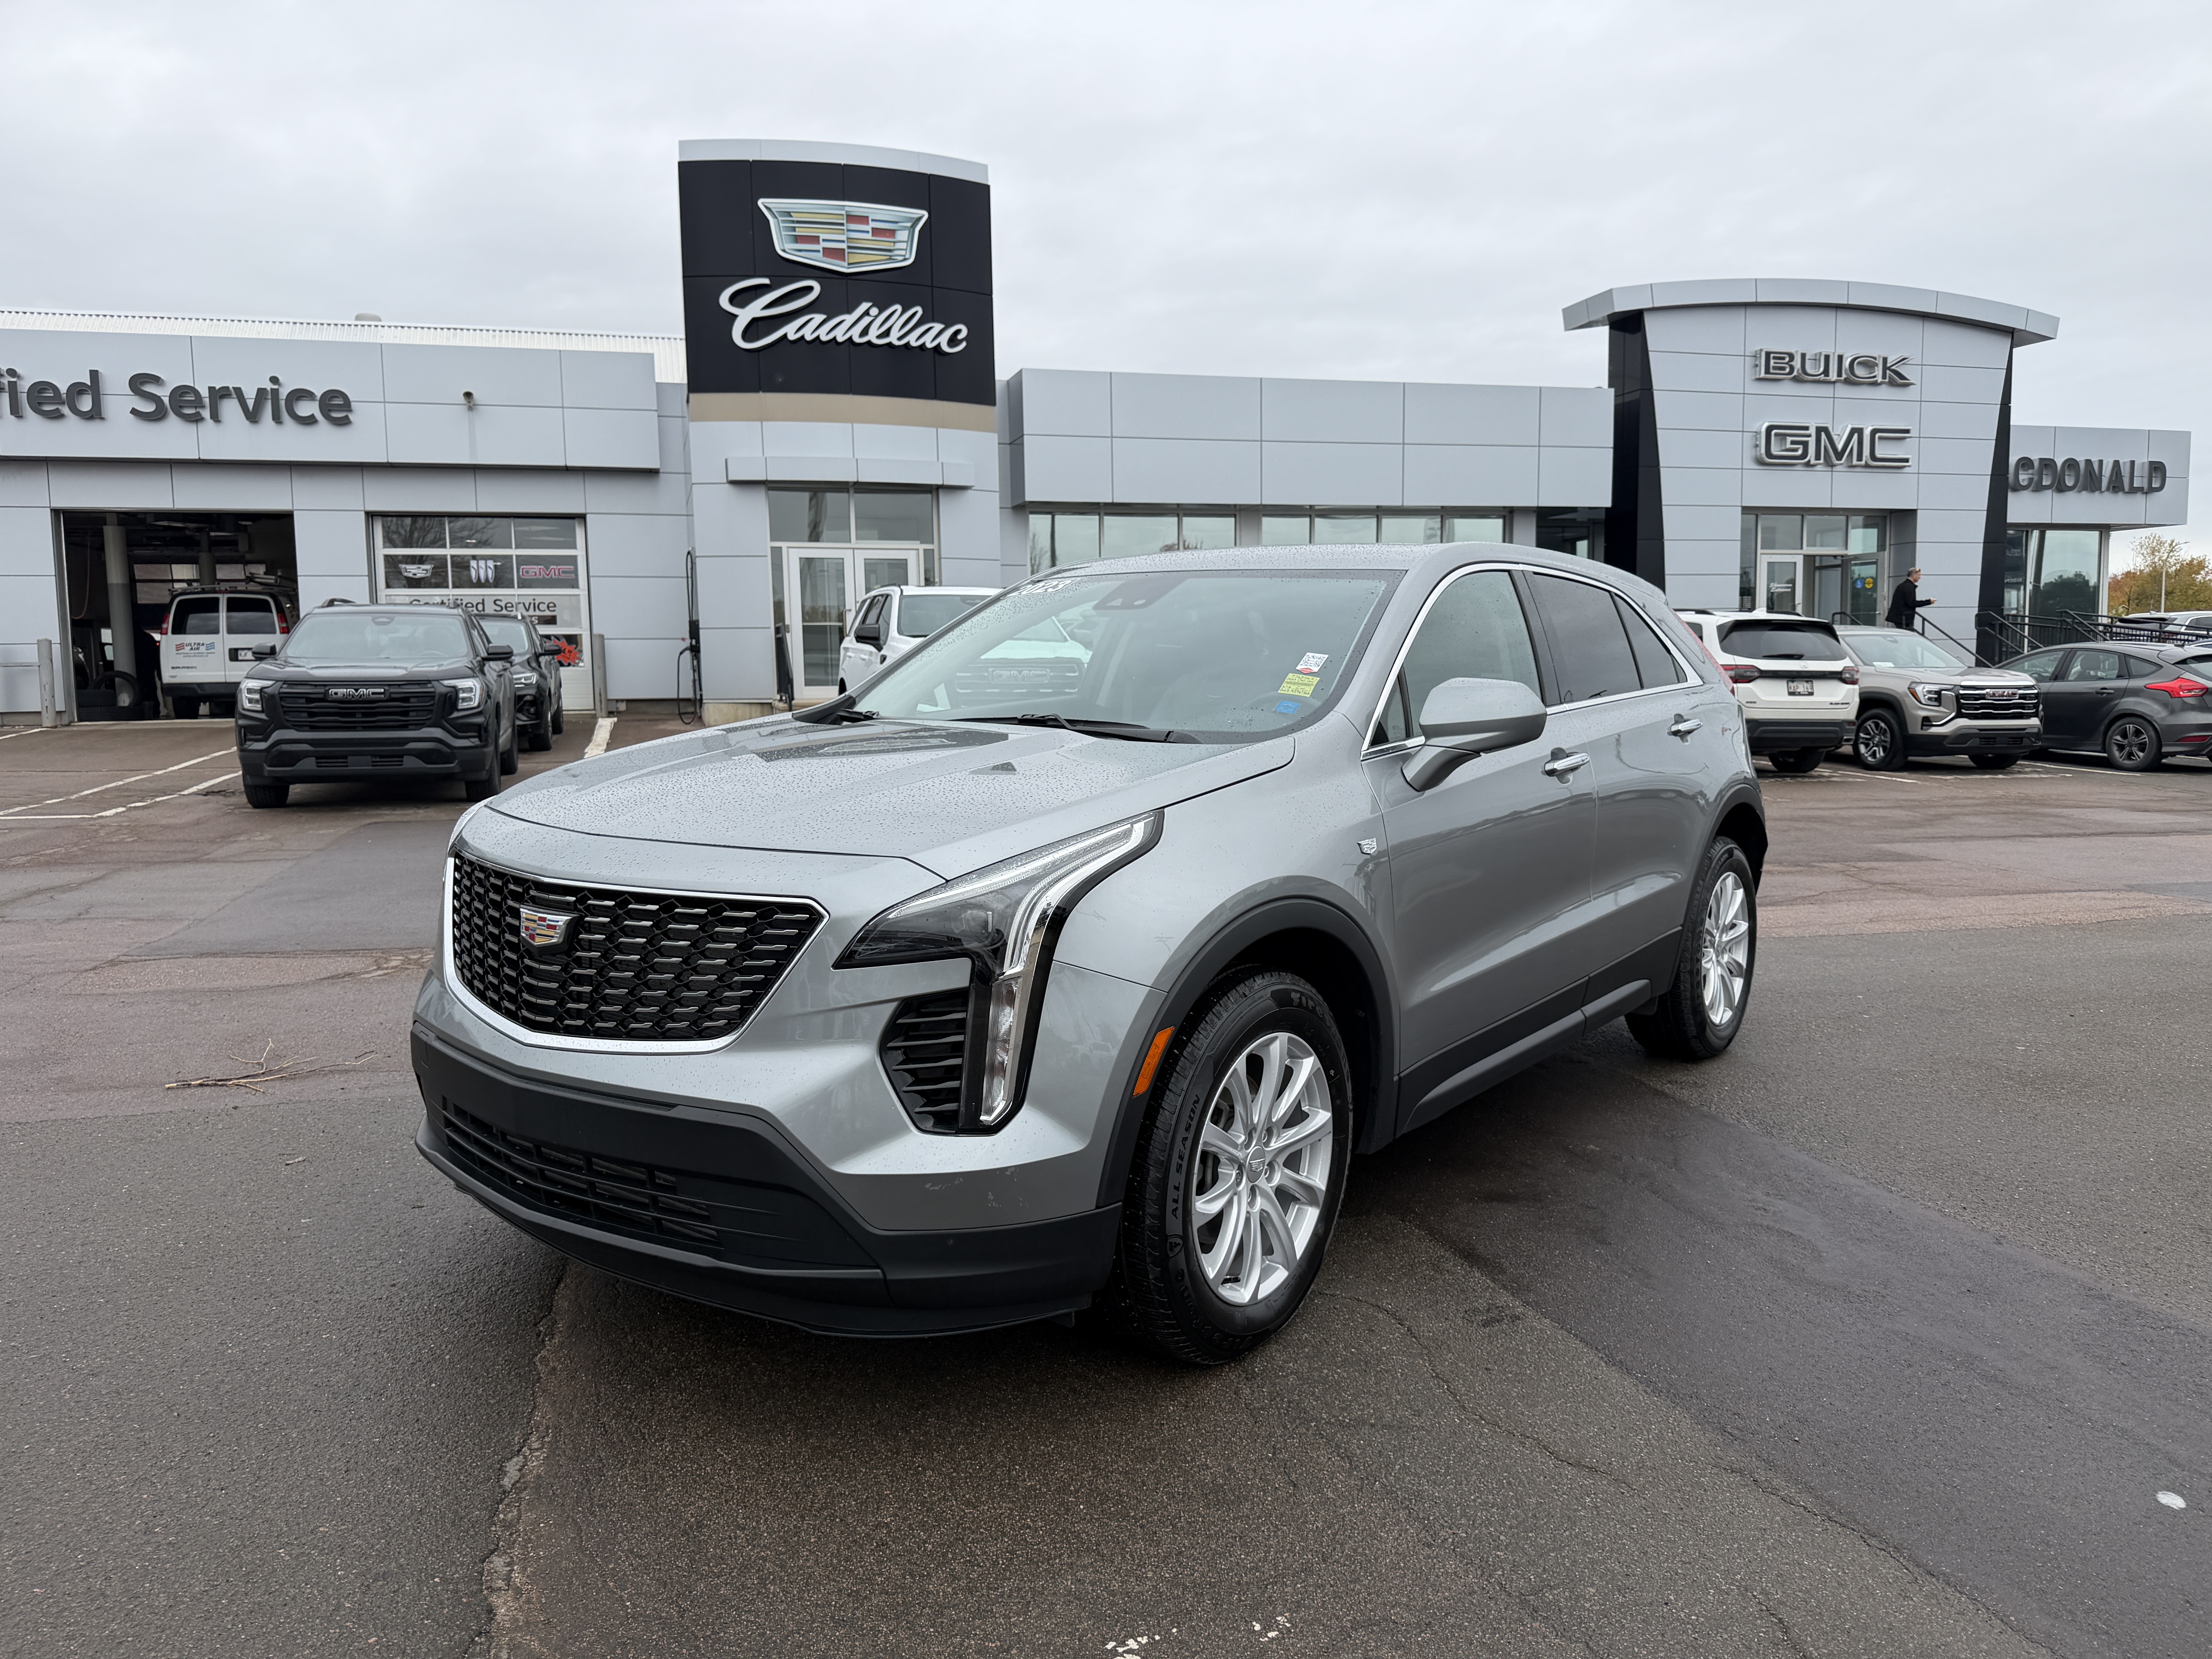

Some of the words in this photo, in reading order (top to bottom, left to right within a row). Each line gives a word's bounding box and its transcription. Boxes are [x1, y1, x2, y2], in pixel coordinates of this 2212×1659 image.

[719, 278, 968, 354] Cadillac
[1755, 349, 1916, 386] BUICK
[0, 367, 105, 419] ied
[128, 373, 352, 425] Service
[1757, 421, 1912, 467] GMC
[520, 565, 575, 578] GMC
[1005, 580, 1072, 597] 2023
[493, 598, 557, 613] Service
[328, 688, 385, 699] GMC
[992, 670, 1048, 682] GMC
[1175, 1094, 1200, 1175] SEASON
[1171, 1181, 1180, 1220] ALL
